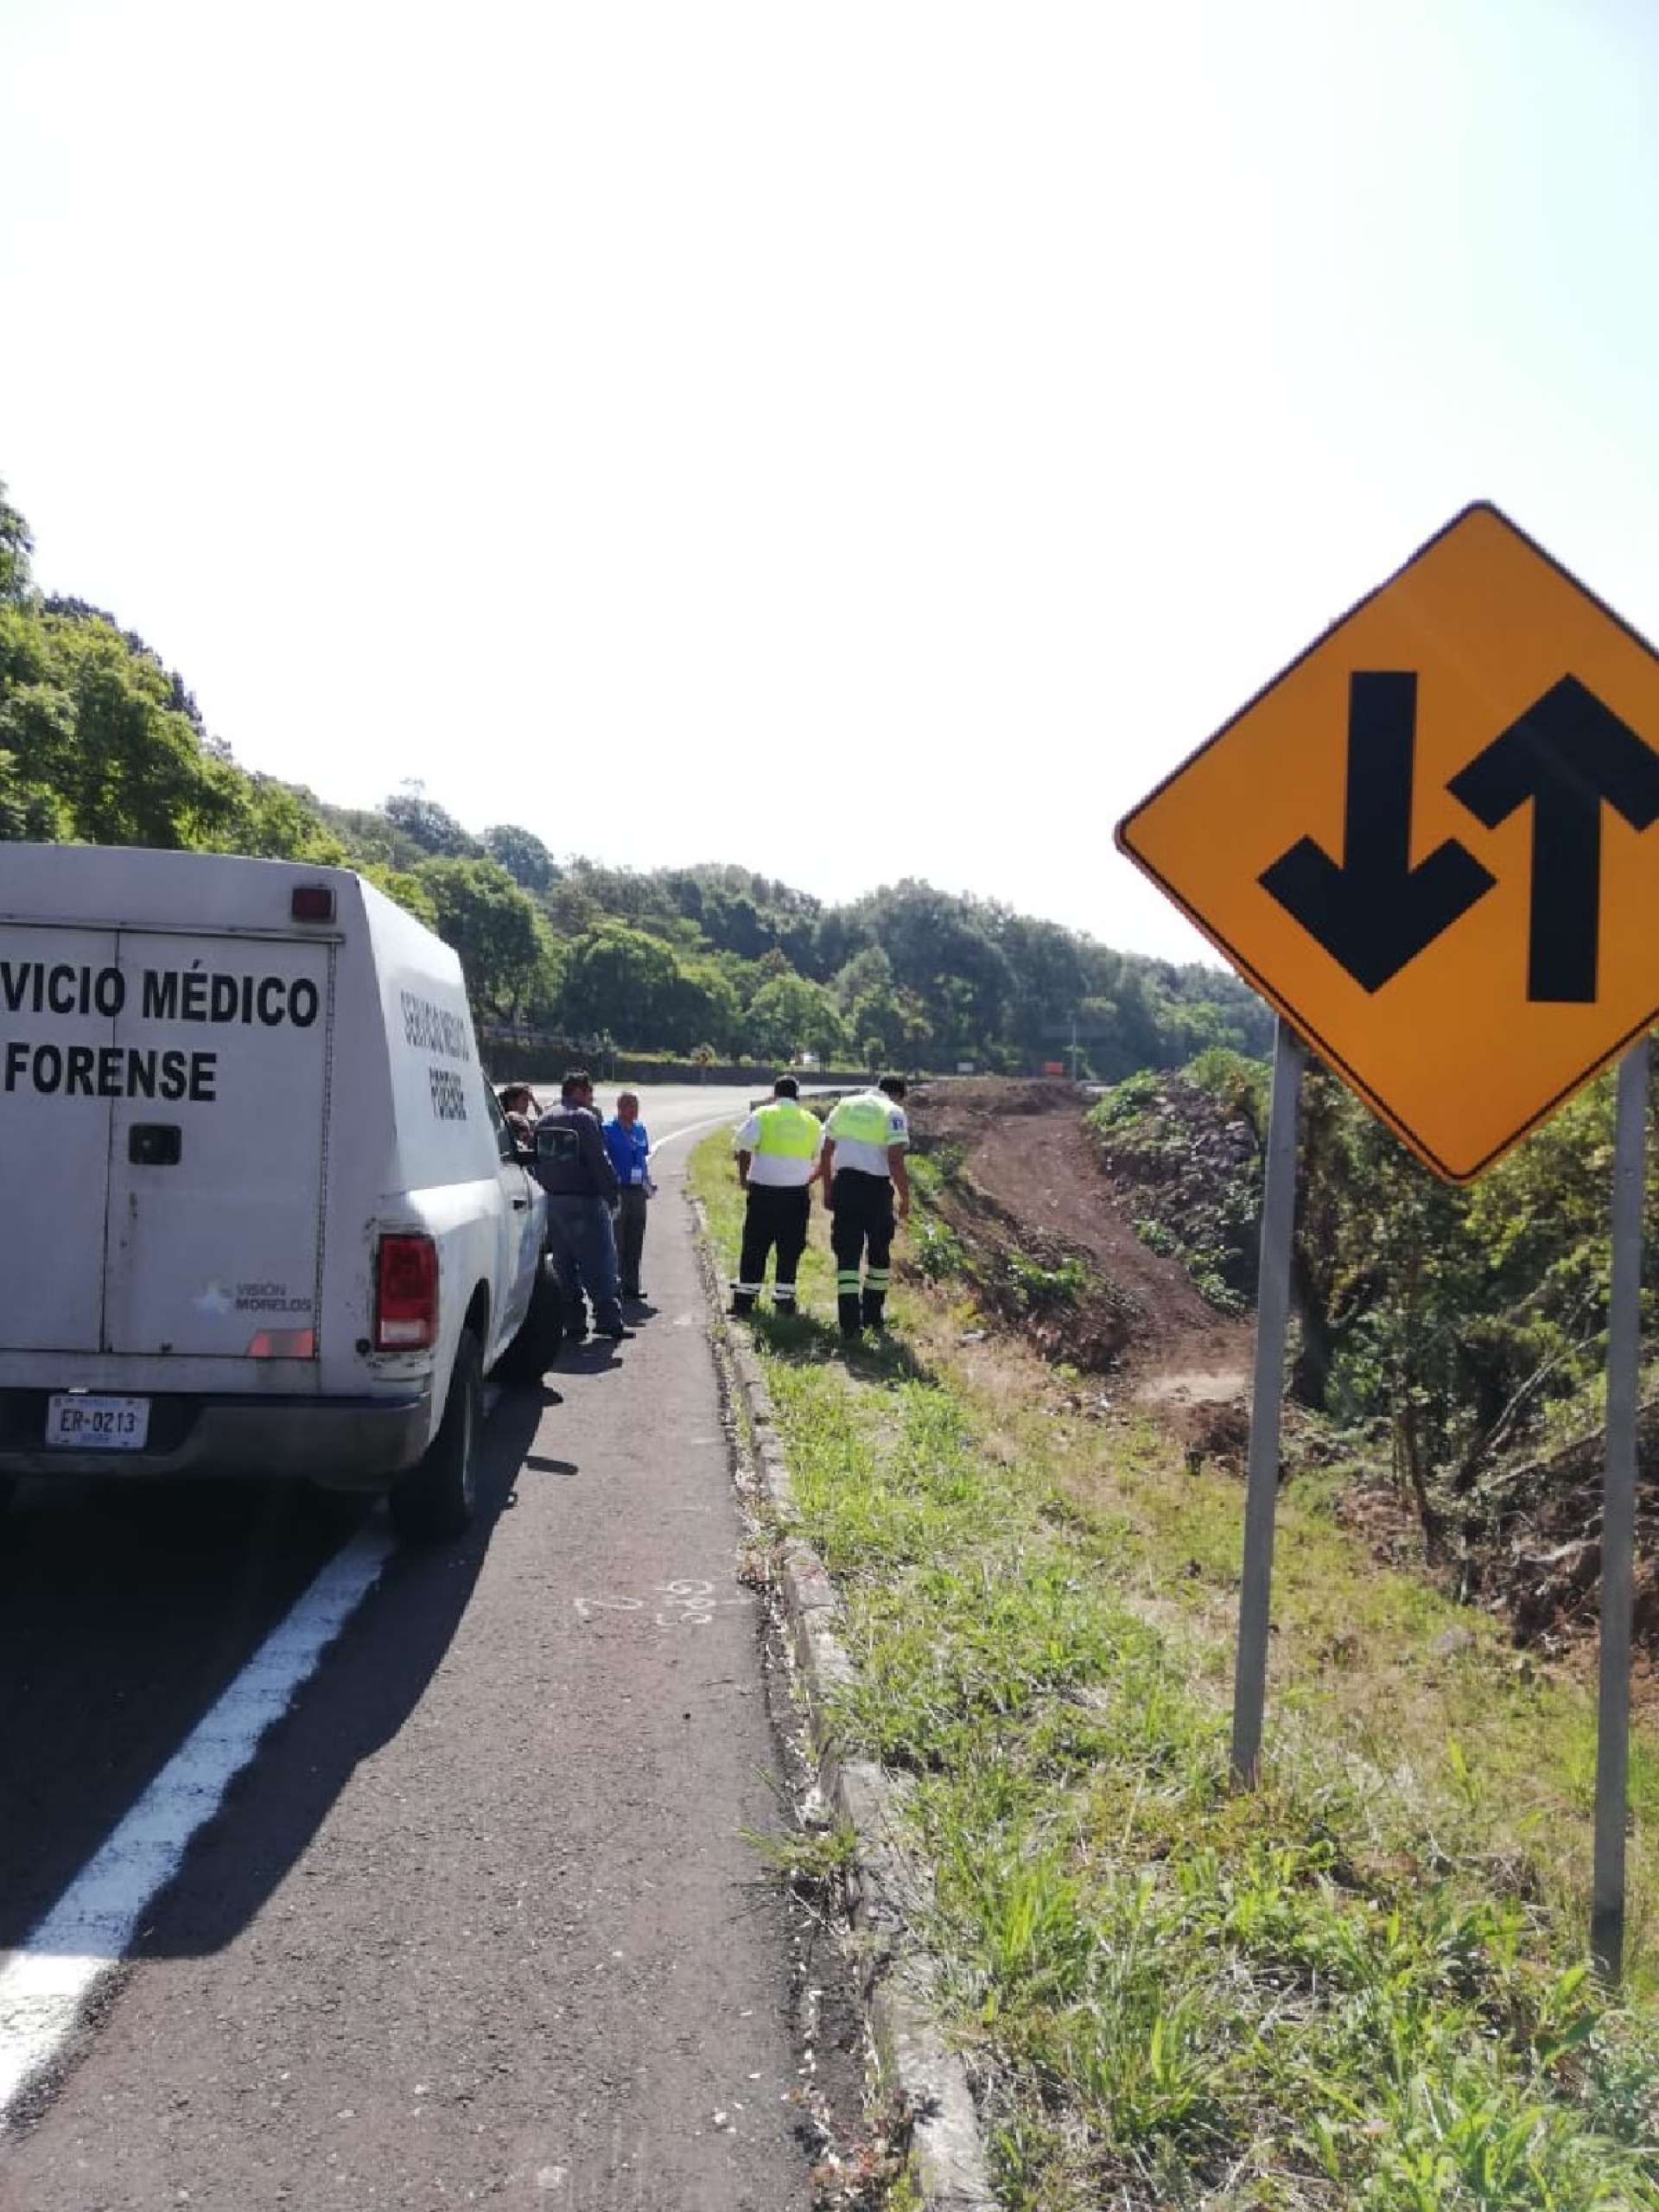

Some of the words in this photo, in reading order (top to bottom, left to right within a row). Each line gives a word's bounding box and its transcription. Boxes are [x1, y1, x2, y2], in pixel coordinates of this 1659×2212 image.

[143, 958, 319, 1027] MÉDICO
[4, 1042, 217, 1102] FORENSE
[235, 1298, 312, 1313] MORELOS
[60, 1408, 135, 1433] ER-0213
